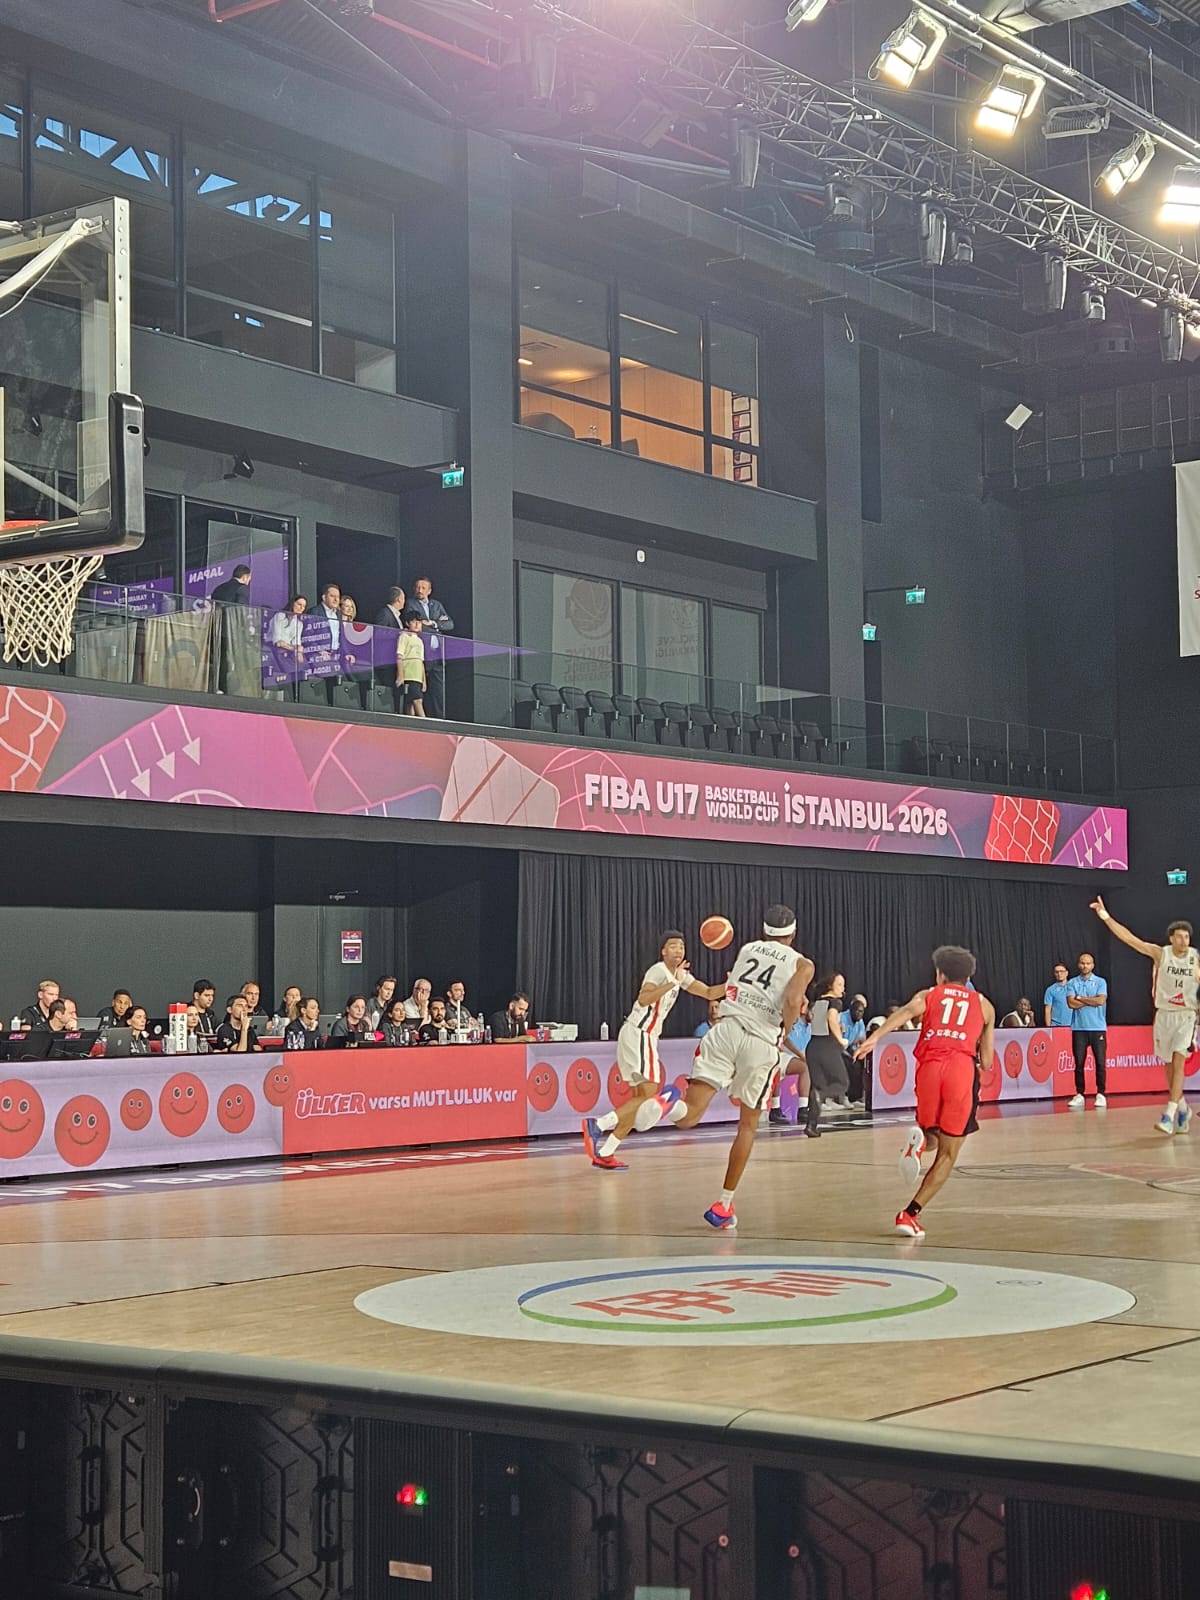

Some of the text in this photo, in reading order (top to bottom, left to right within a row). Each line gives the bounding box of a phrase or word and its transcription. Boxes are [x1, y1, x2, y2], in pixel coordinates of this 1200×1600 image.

[584, 773, 699, 815] FIBA U17
[704, 785, 780, 806] BASKETBALL
[705, 801, 779, 822] WORLD CUP
[784, 781, 948, 836] İSTANBUL 2026
[738, 958, 777, 990] 24
[1167, 965, 1193, 977] FRANCE
[1175, 979, 1184, 989] 14
[940, 997, 969, 1027] 11
[1057, 1050, 1095, 1072] ÜLR
[1116, 1054, 1158, 1068] MUTLULUK
[295, 1087, 518, 1119] ÜLKER varsa MUTLULUK var
